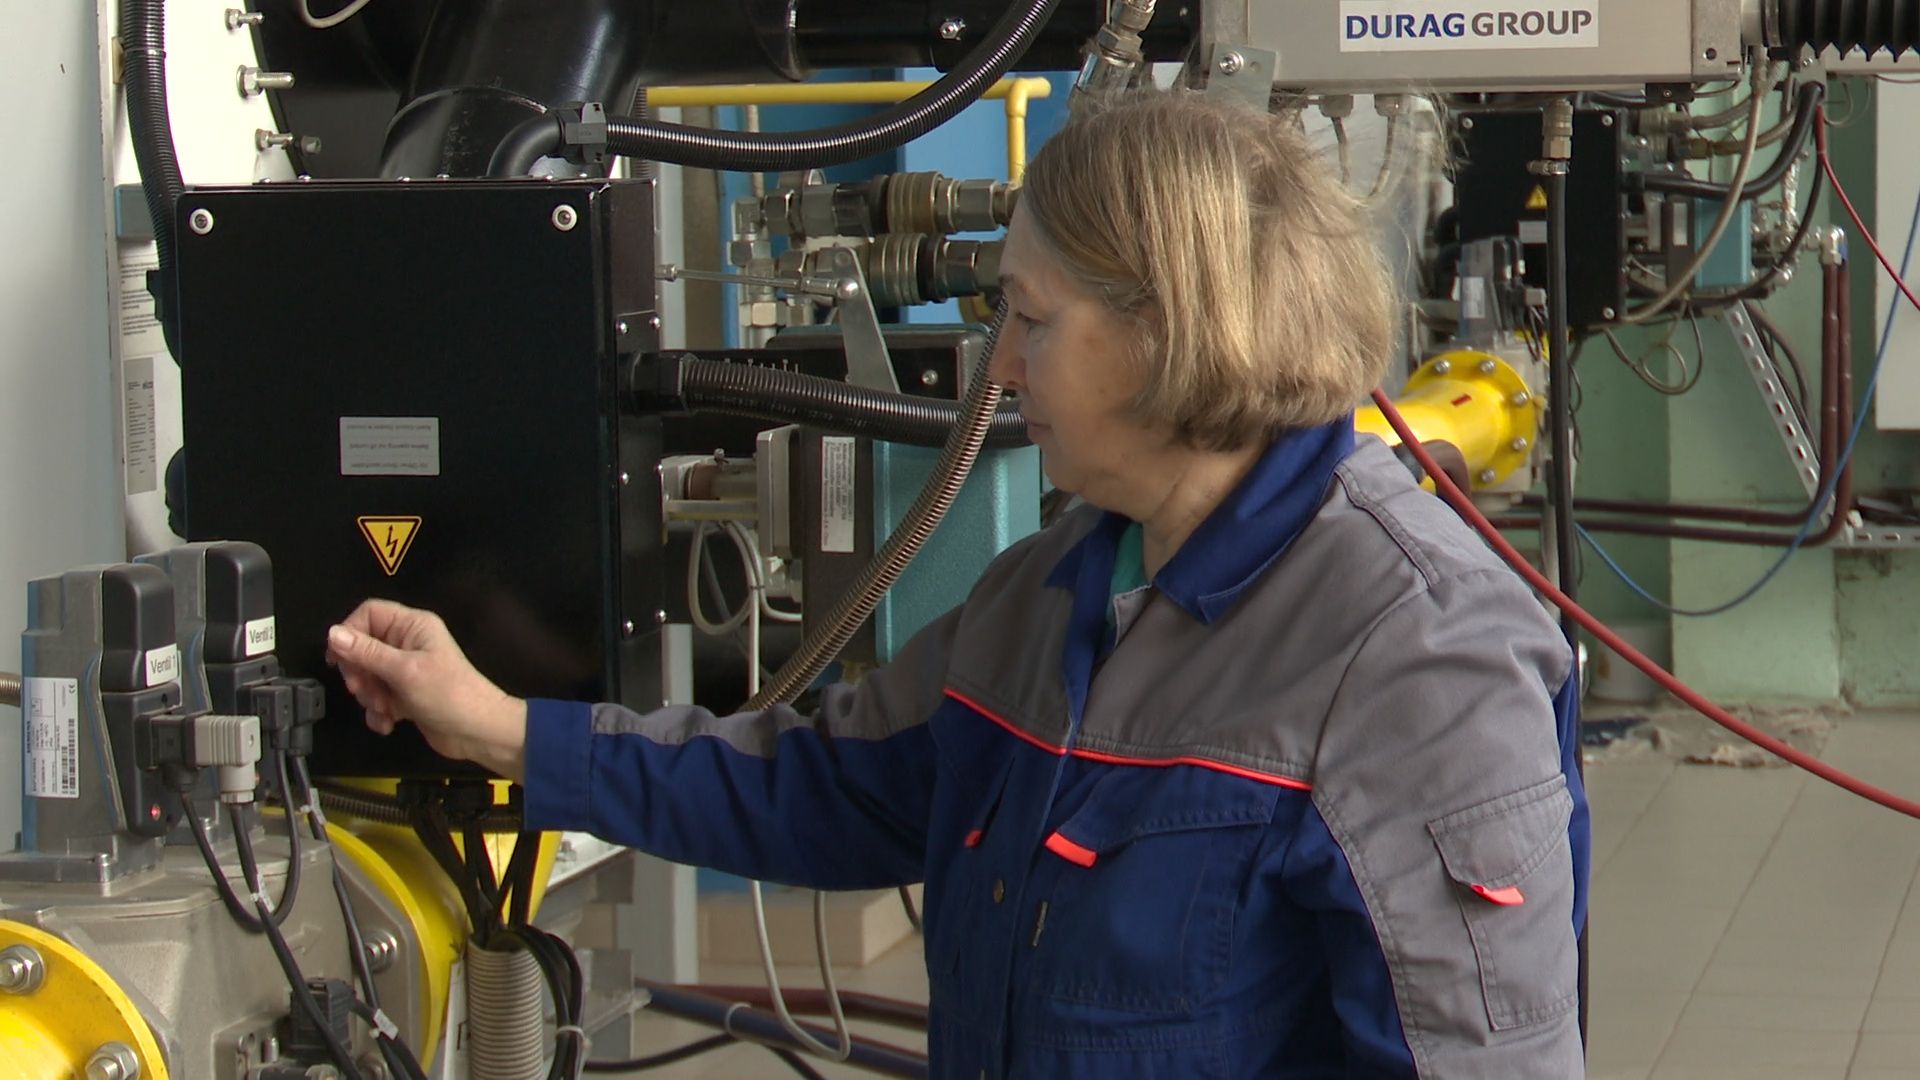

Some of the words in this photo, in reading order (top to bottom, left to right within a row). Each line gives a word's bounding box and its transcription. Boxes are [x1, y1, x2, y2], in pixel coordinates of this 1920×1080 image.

[1346, 13, 1465, 39] DURAG
[1471, 10, 1592, 36] GROUP
[249, 628, 269, 644] Ventil
[151, 657, 172, 674] Ventil
